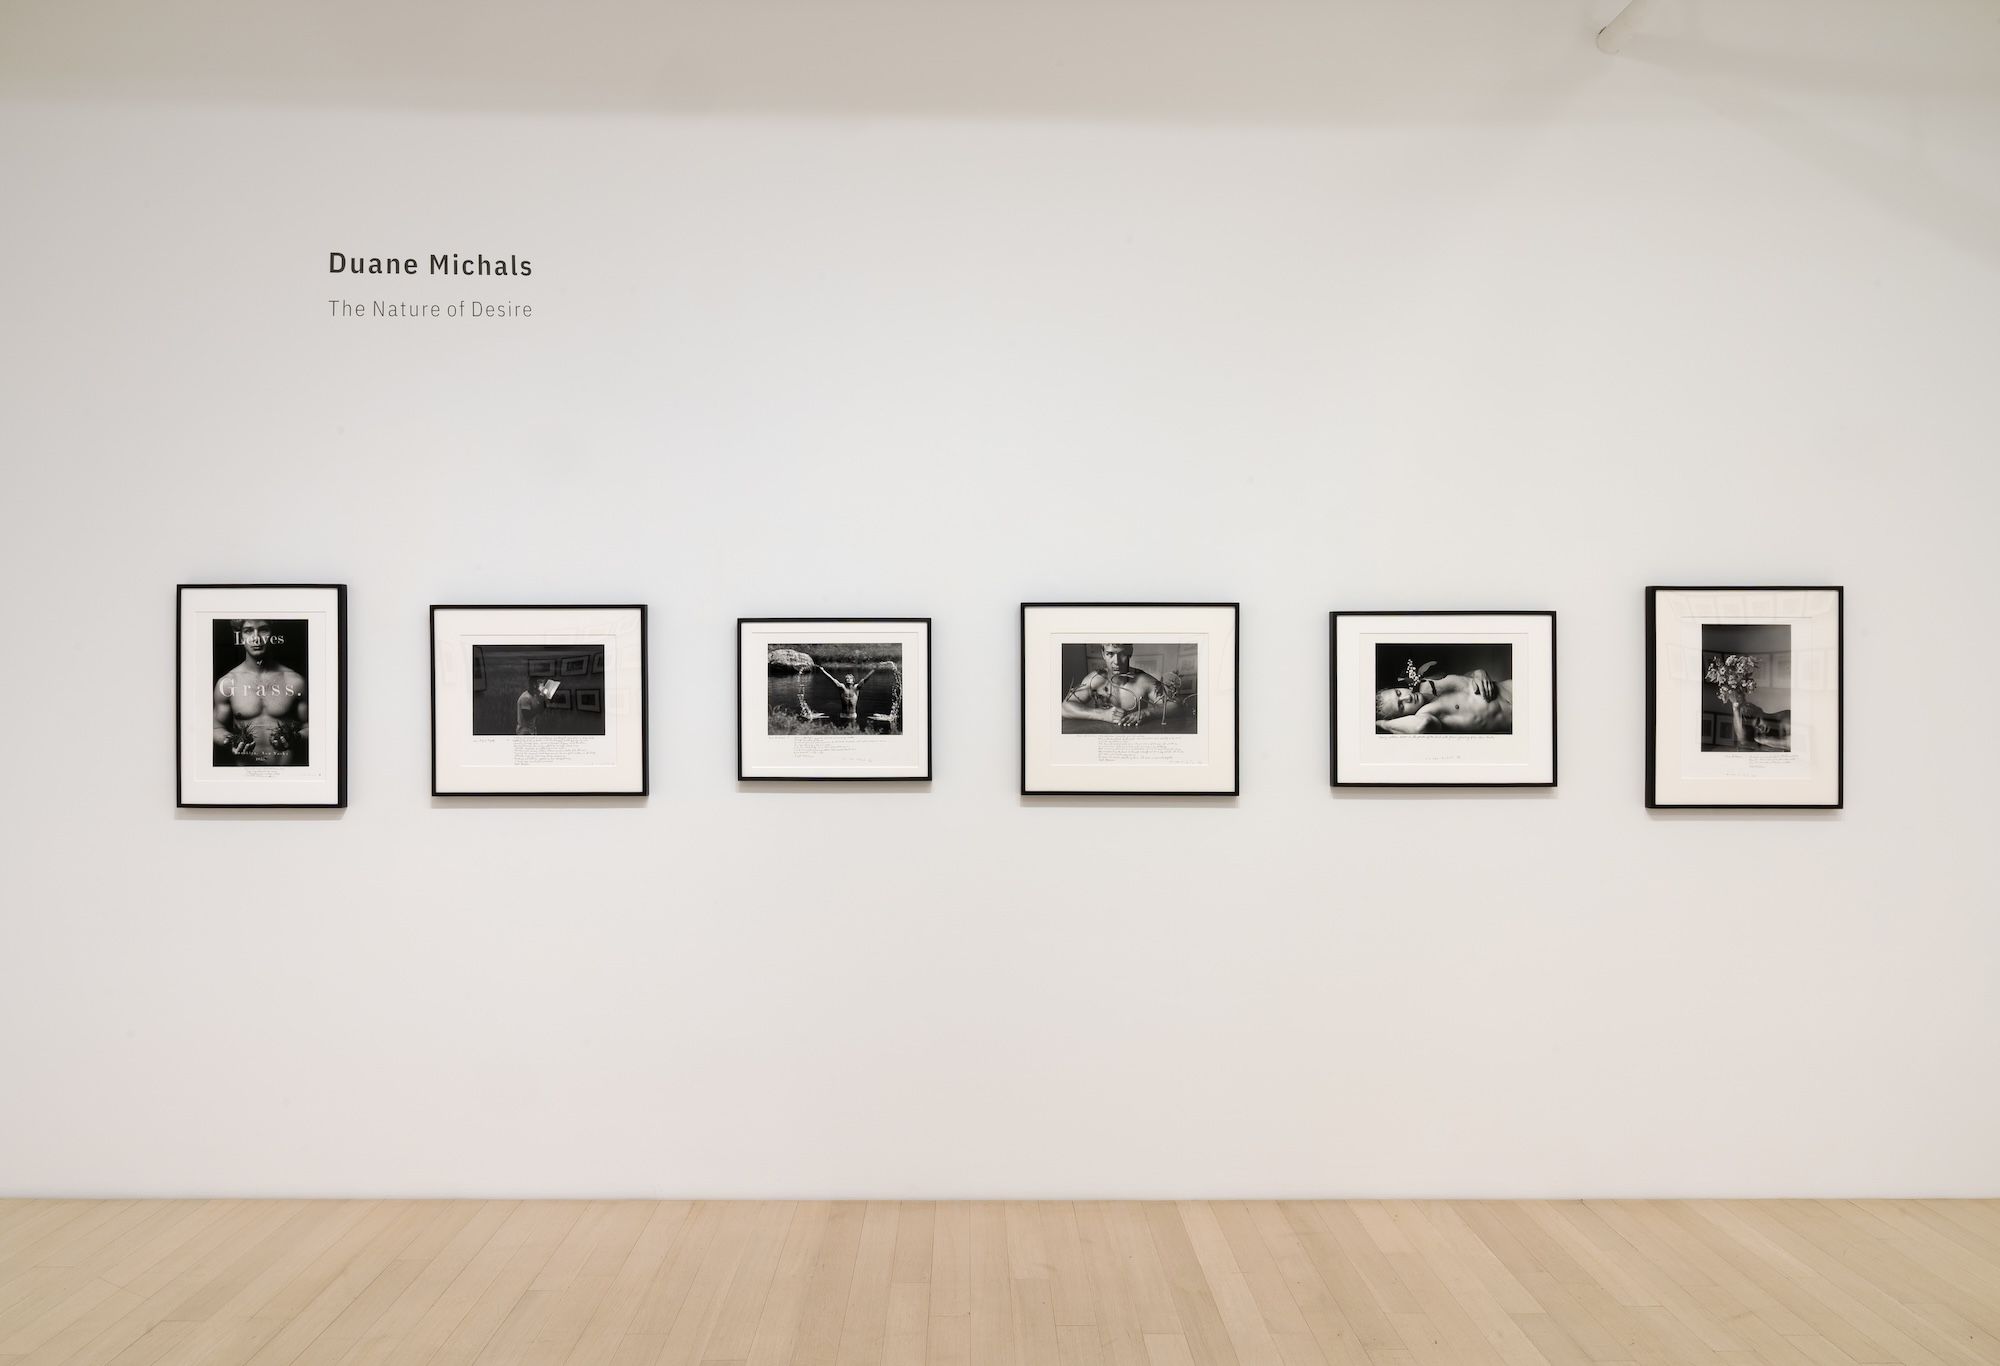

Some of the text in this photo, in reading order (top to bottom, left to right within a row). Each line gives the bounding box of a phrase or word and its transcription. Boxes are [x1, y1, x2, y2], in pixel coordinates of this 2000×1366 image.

[329, 251, 533, 277] Duane Michals
[328, 299, 533, 318] The Nature of Desire
[233, 631, 285, 646] Leaves
[219, 677, 302, 697] Grass.
